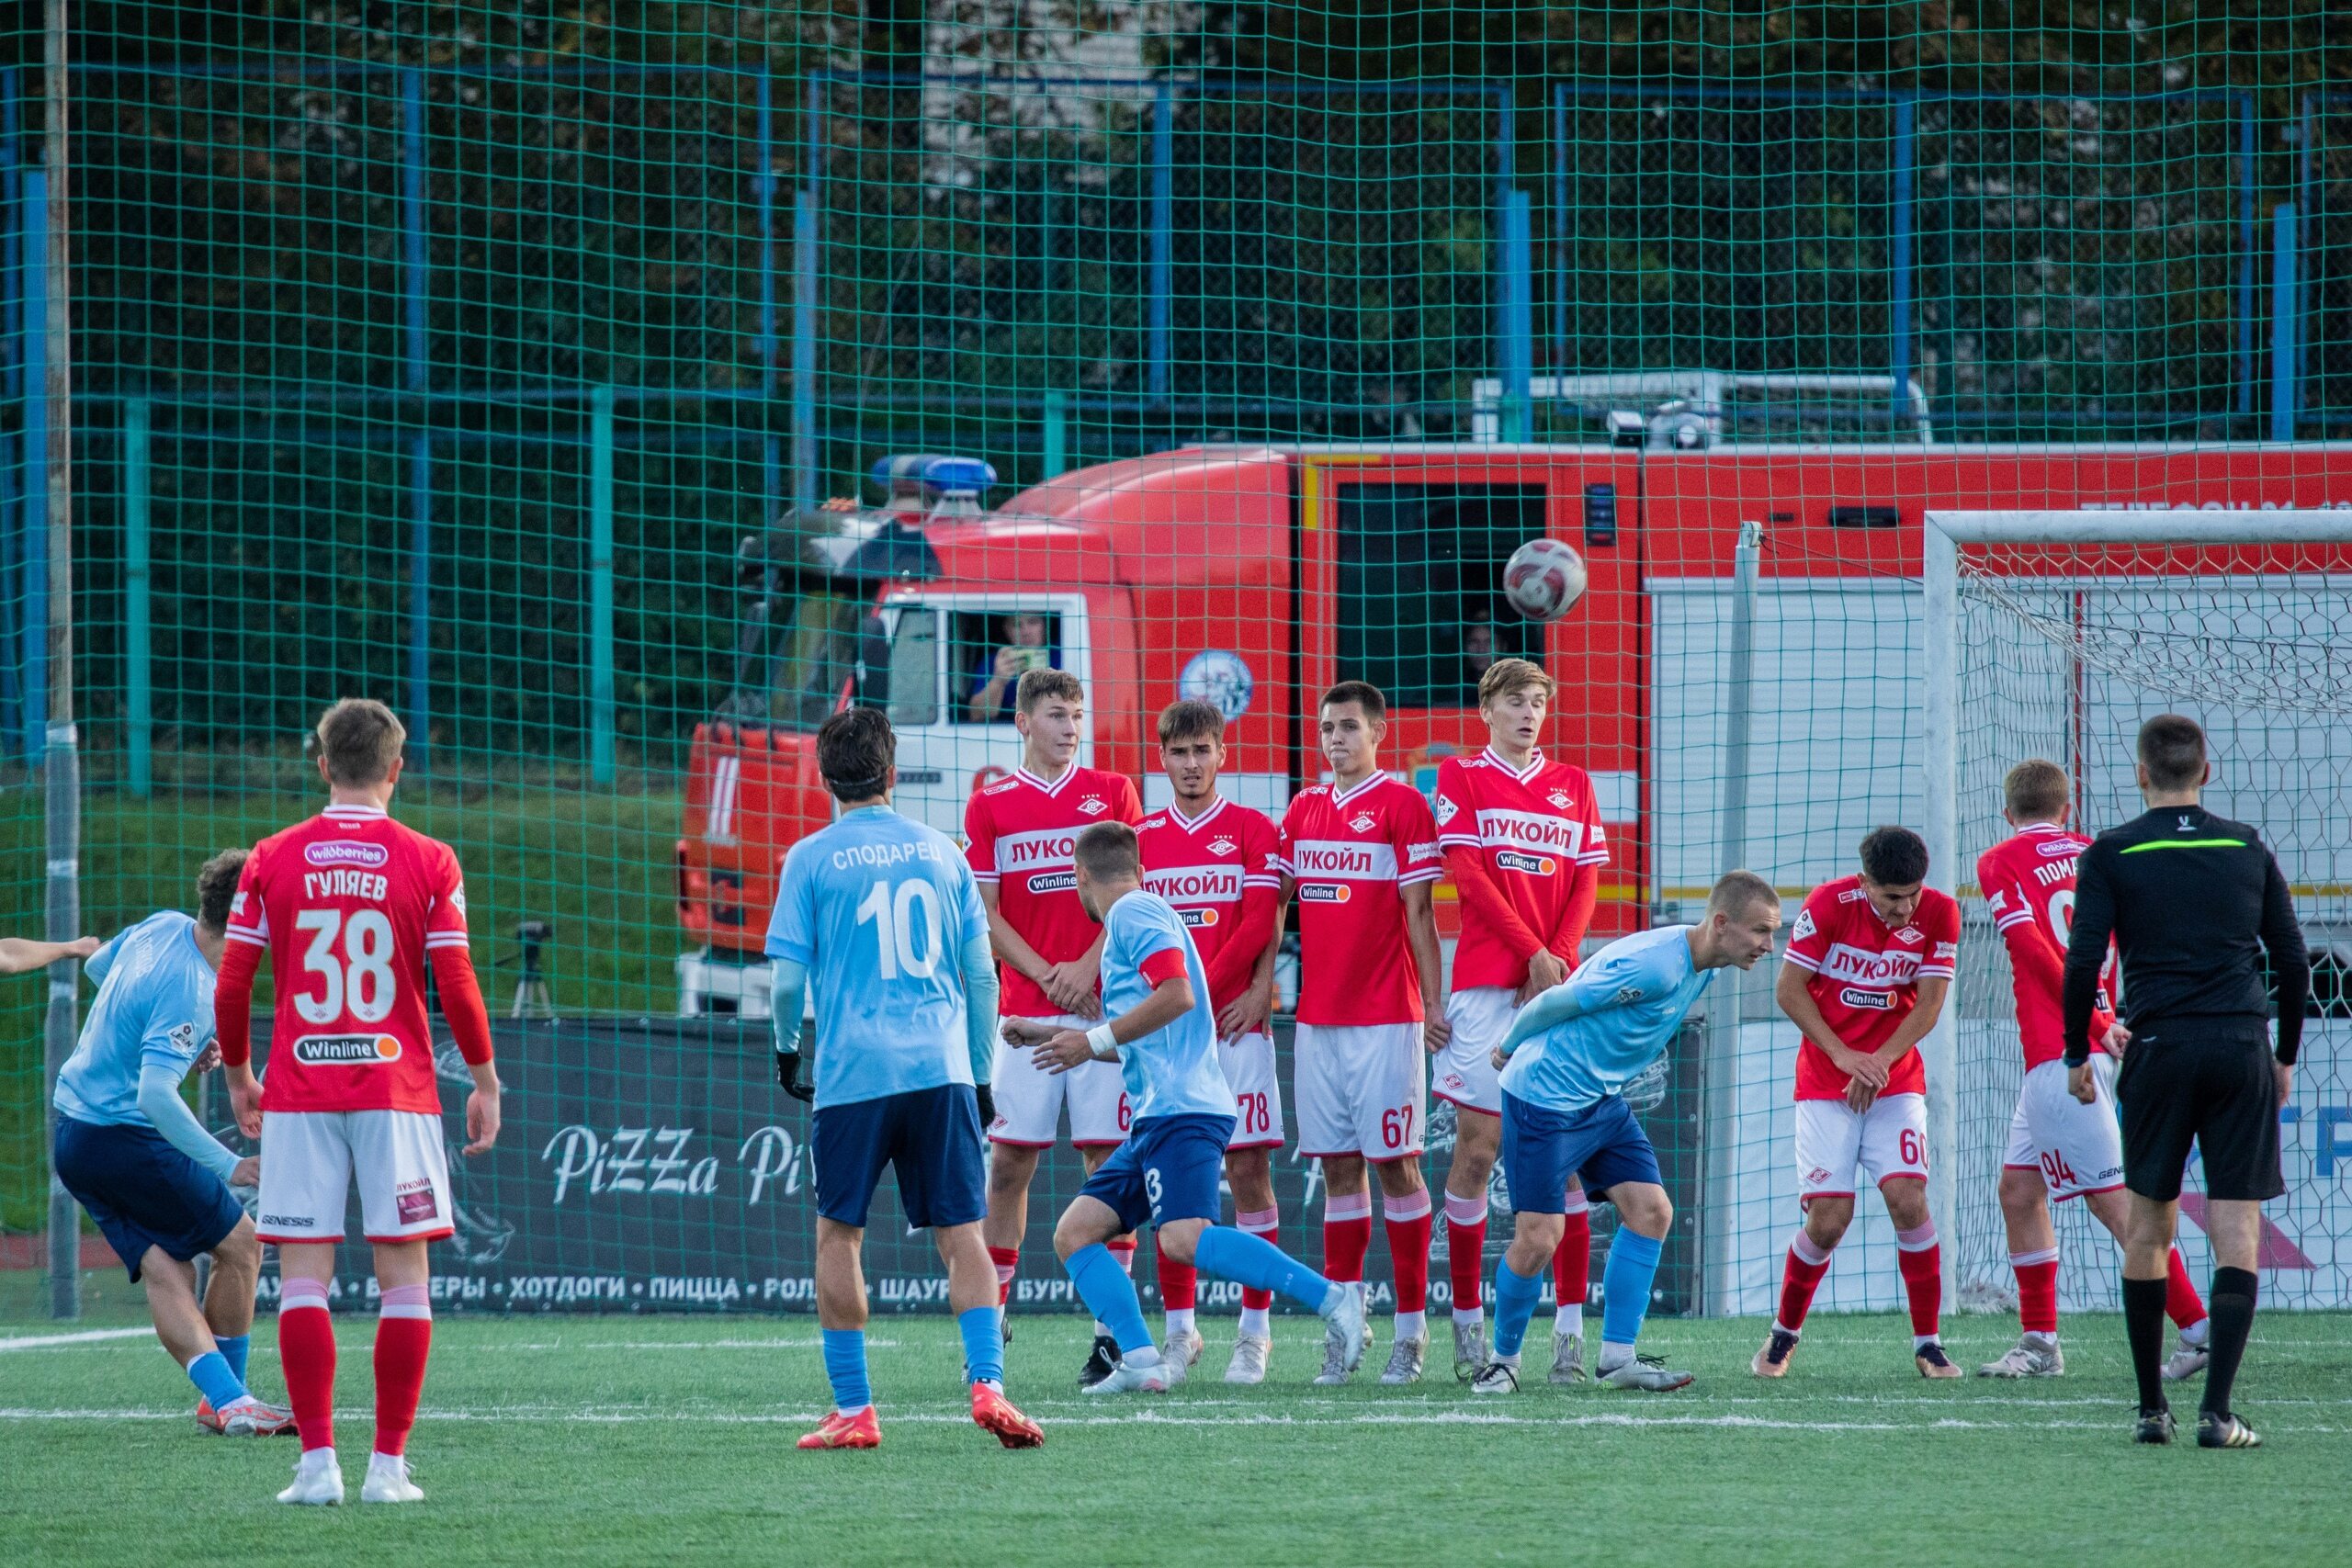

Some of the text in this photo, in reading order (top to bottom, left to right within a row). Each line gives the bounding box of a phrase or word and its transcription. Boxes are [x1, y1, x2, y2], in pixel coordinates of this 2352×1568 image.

[1482, 817, 1572, 850] ЛУКОЙЛ
[832, 841, 944, 870] СПОДАРЕЦ
[1012, 837, 1076, 863] ЛУКО
[1499, 854, 1537, 871] Winline
[303, 869, 388, 901] ГУЛЯЕВ
[1033, 875, 1078, 889] Winline
[1303, 886, 1334, 899] Winline
[856, 878, 943, 979] 10
[293, 908, 397, 1025] 38
[1831, 952, 1920, 980] ЛУКОЙЛ
[1847, 991, 1885, 1006] Winline
[304, 1040, 371, 1058] Winline
[1237, 1091, 1270, 1134] 78
[1382, 1104, 1412, 1148] 67
[2041, 1148, 2077, 1189] 94
[262, 1214, 314, 1228] GENESIS
[509, 1275, 626, 1301] ХОТДОГИ
[650, 1277, 741, 1303] ПИЦЦА
[763, 1278, 818, 1300] РОЛ
[879, 1278, 950, 1301] ШАУР
